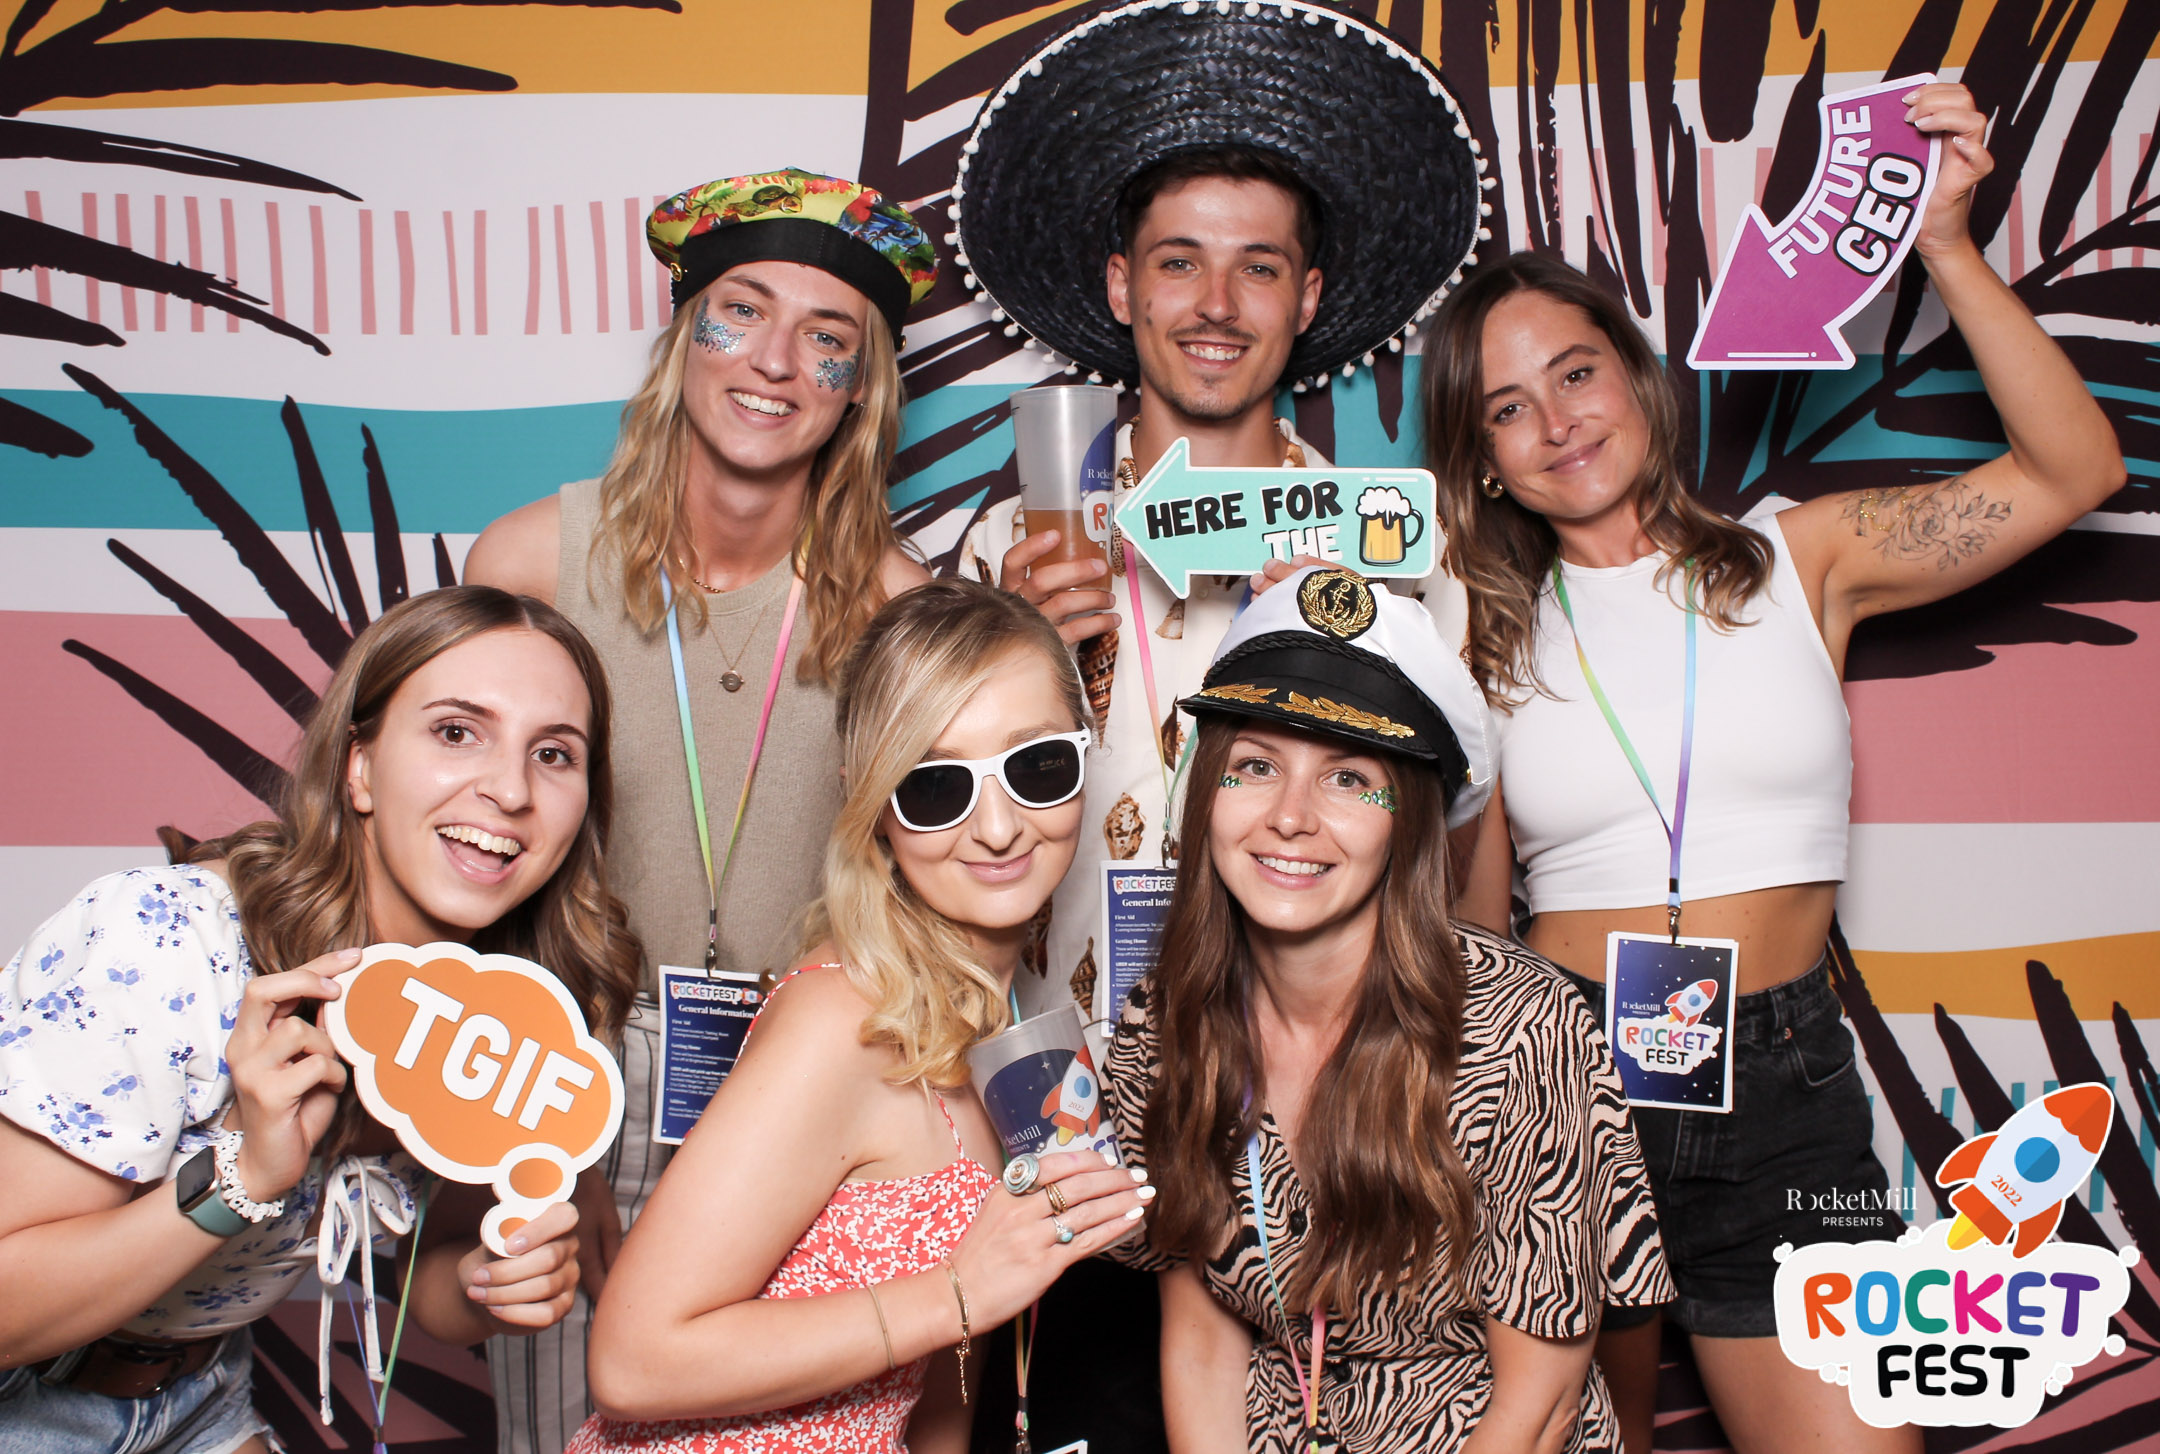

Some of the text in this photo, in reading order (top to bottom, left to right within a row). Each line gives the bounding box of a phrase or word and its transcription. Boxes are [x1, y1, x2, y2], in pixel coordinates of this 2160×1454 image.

[1768, 105, 1872, 279] FUTURE
[1836, 155, 1923, 274] CEO
[1144, 480, 1344, 540] HERE FOR
[1261, 524, 1343, 561] THE
[1116, 879, 1176, 890] ROCKET FES
[1122, 898, 1154, 907] General
[673, 984, 737, 1000] ROCKET FEST
[678, 1004, 755, 1019] General Information
[1626, 1026, 1711, 1051] ROCKET
[393, 976, 595, 1131] TGIF
[1646, 1048, 1690, 1066] FEST
